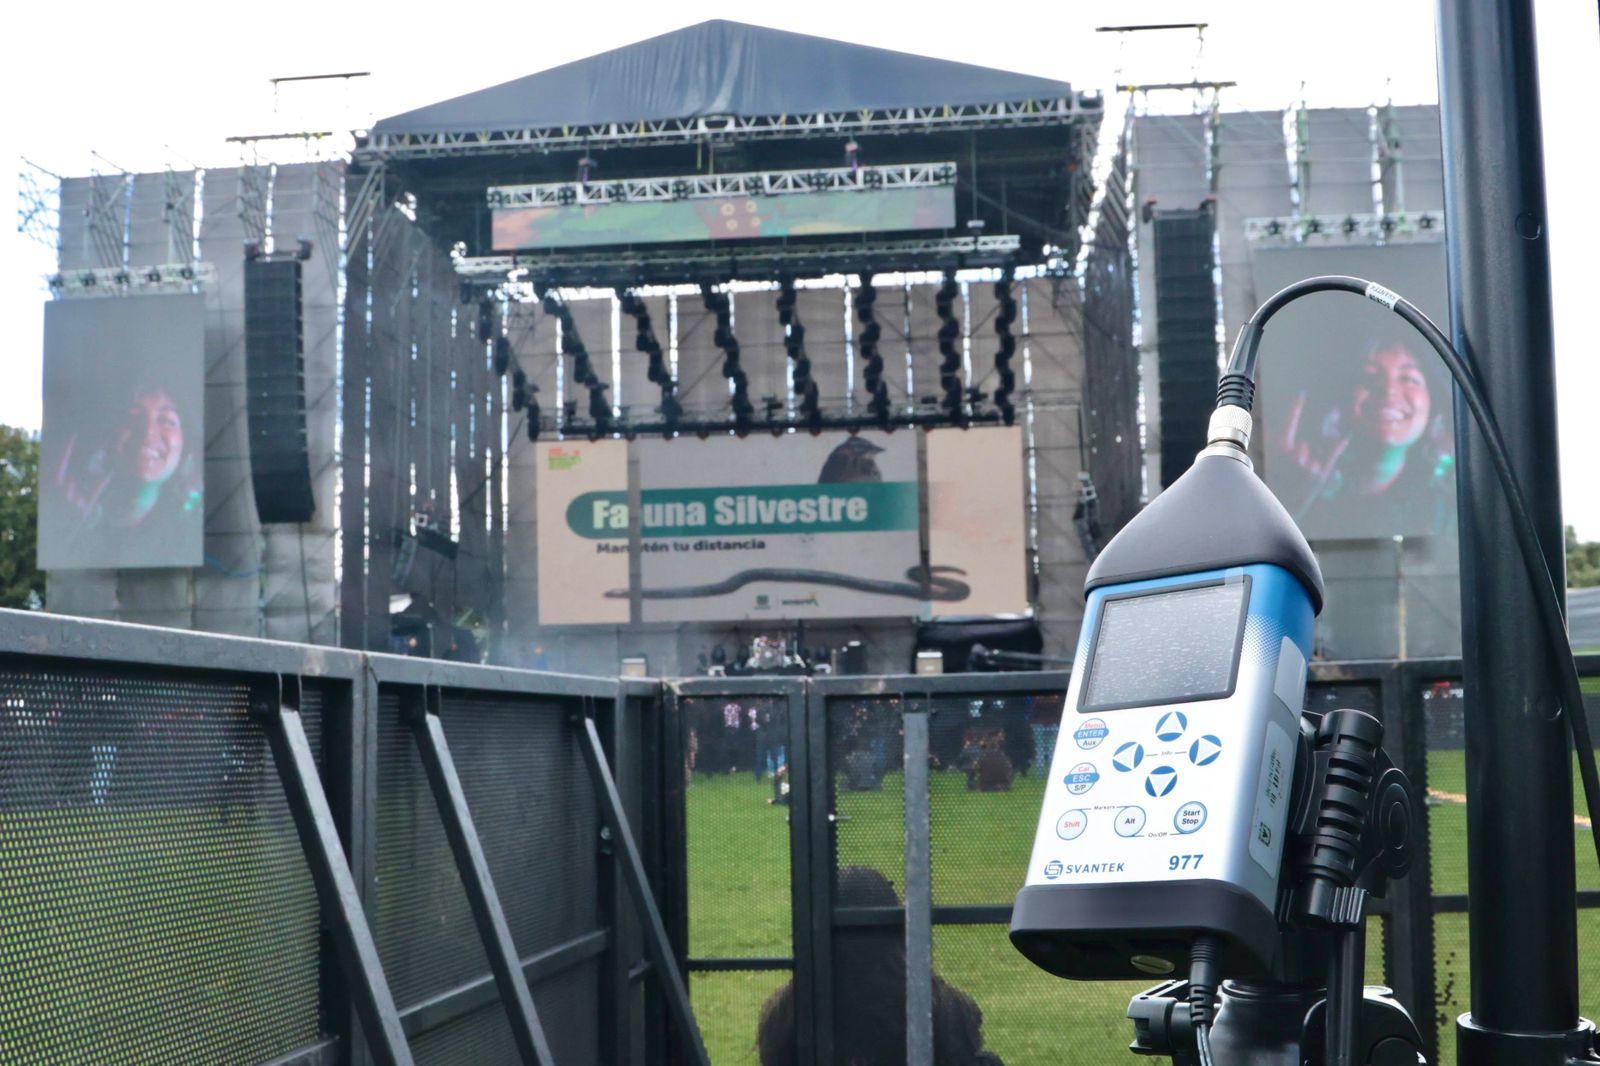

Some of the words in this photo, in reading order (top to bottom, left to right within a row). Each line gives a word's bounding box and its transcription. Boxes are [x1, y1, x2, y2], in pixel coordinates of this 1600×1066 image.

[592, 500, 706, 529] Fauna
[713, 495, 868, 526] Silvestre
[673, 541, 690, 552] tu
[693, 538, 766, 551] distancia
[1077, 729, 1104, 738] ENTER
[1072, 773, 1091, 782] ESC
[1182, 809, 1201, 817] Start
[1181, 818, 1199, 826] Stop
[1066, 862, 1125, 873] SVANTEK
[1168, 854, 1204, 871] 977
